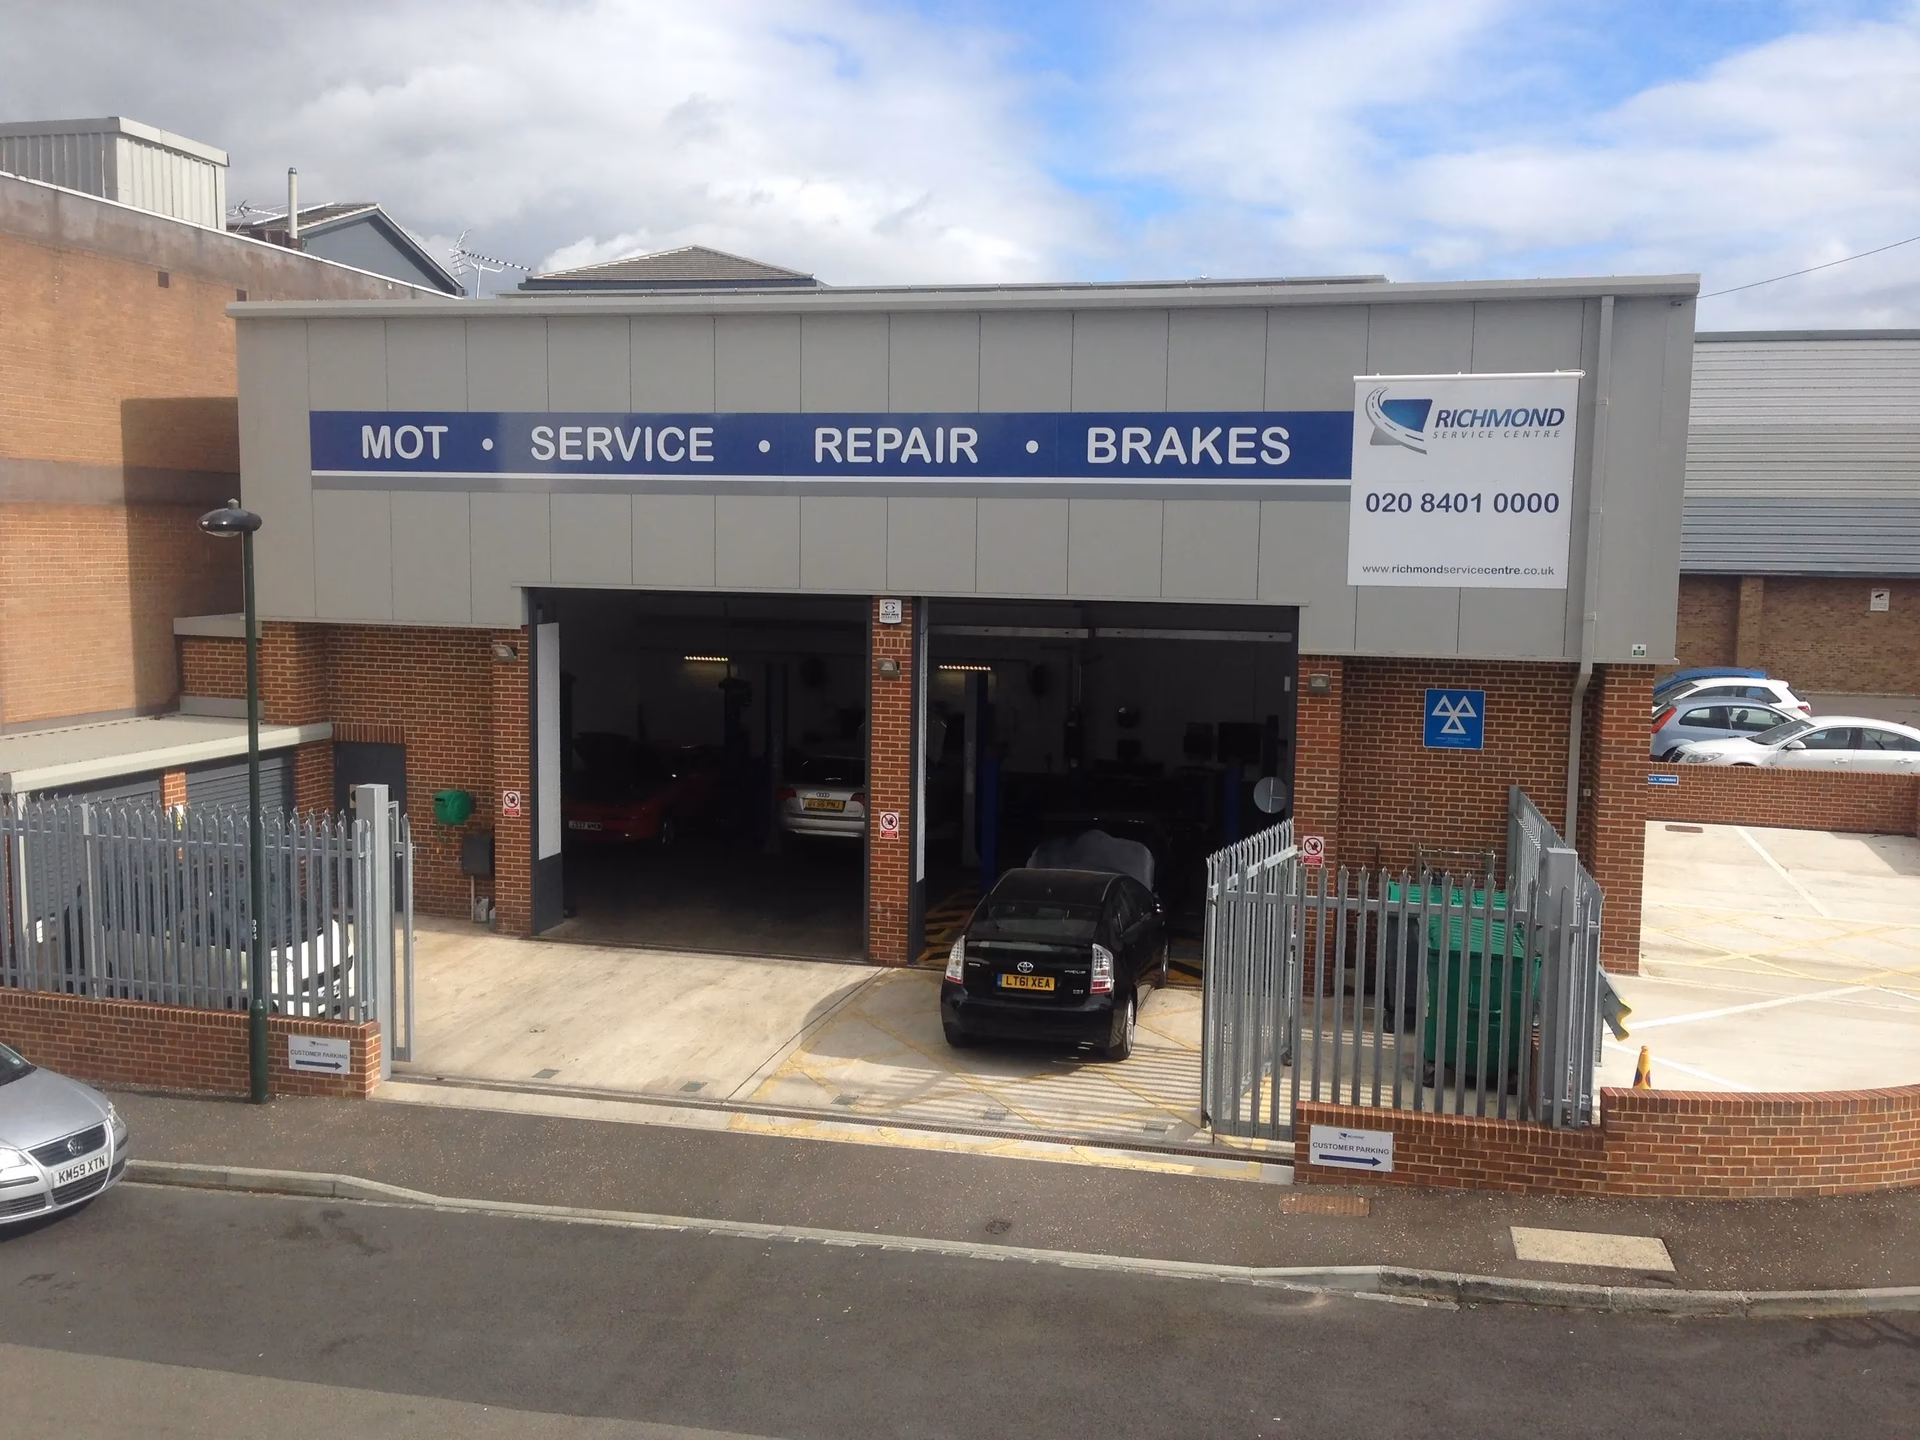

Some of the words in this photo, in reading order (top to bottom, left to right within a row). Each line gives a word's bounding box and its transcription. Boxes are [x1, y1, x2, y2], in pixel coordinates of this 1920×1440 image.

[1434, 408, 1565, 428] RICHMOND
[1432, 430, 1494, 439] SERVICE
[1503, 429, 1561, 438] CENTRE
[361, 425, 449, 459] MOT
[531, 426, 715, 461] SERVICE
[814, 427, 979, 464] REPAIR
[1087, 427, 1291, 465] BRAKES
[1365, 492, 1413, 513] 020
[1420, 492, 1482, 513] 8401
[1493, 492, 1560, 513] 0000
[1362, 564, 1555, 576] www.richmondservicecentre.co.uk
[1006, 975, 1029, 987] LT61
[1031, 977, 1051, 989] XEA
[290, 1049, 322, 1057] CUSTOMER
[1312, 1141, 1354, 1152] CUSTOMER
[1355, 1146, 1390, 1155] PARKING
[58, 1163, 86, 1184] KM59
[87, 1155, 105, 1173] XTN
